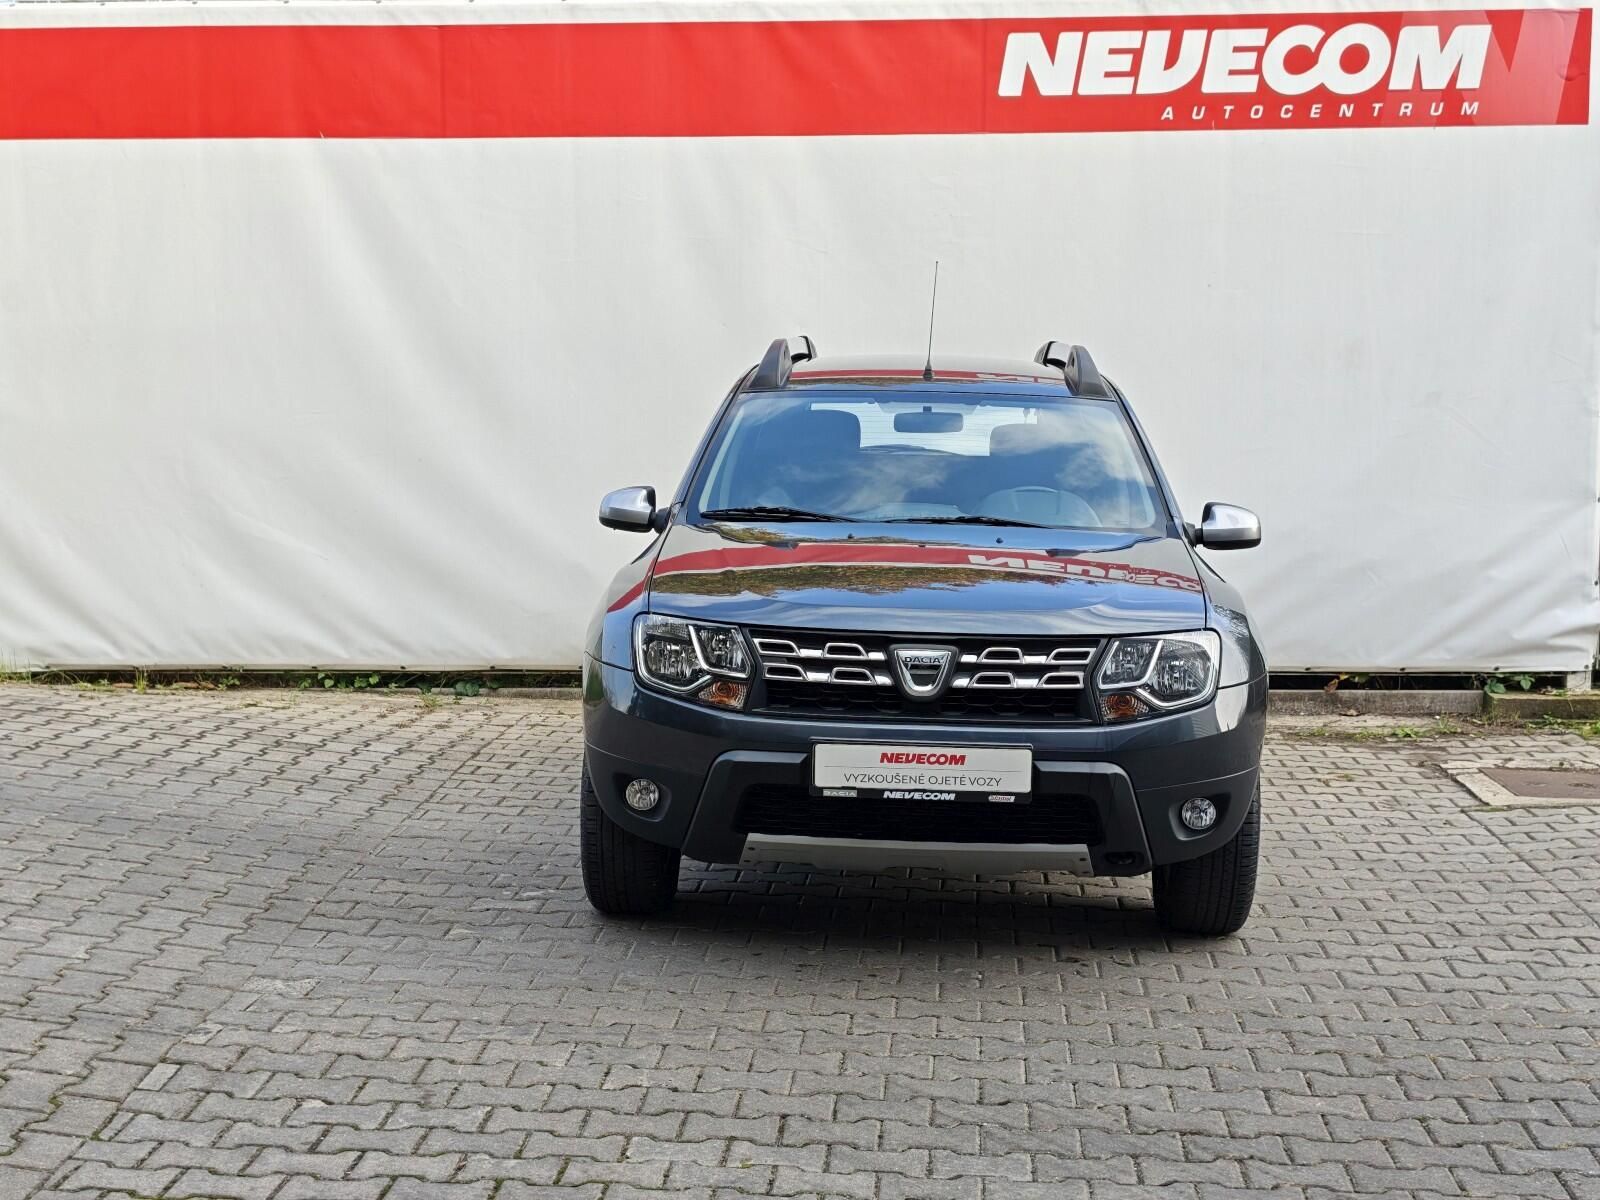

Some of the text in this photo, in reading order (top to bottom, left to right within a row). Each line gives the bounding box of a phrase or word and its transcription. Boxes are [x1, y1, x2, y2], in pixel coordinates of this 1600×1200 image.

[998, 22, 1492, 96] NEVECOM
[1161, 101, 1482, 121] AUTOCENTRUM
[904, 656, 941, 664] DACIA
[880, 752, 966, 765] NEVECOM
[843, 772, 1002, 787] VYZKOUŠENÉ OJETÉ VOZY
[883, 790, 956, 800] NEVECOM
